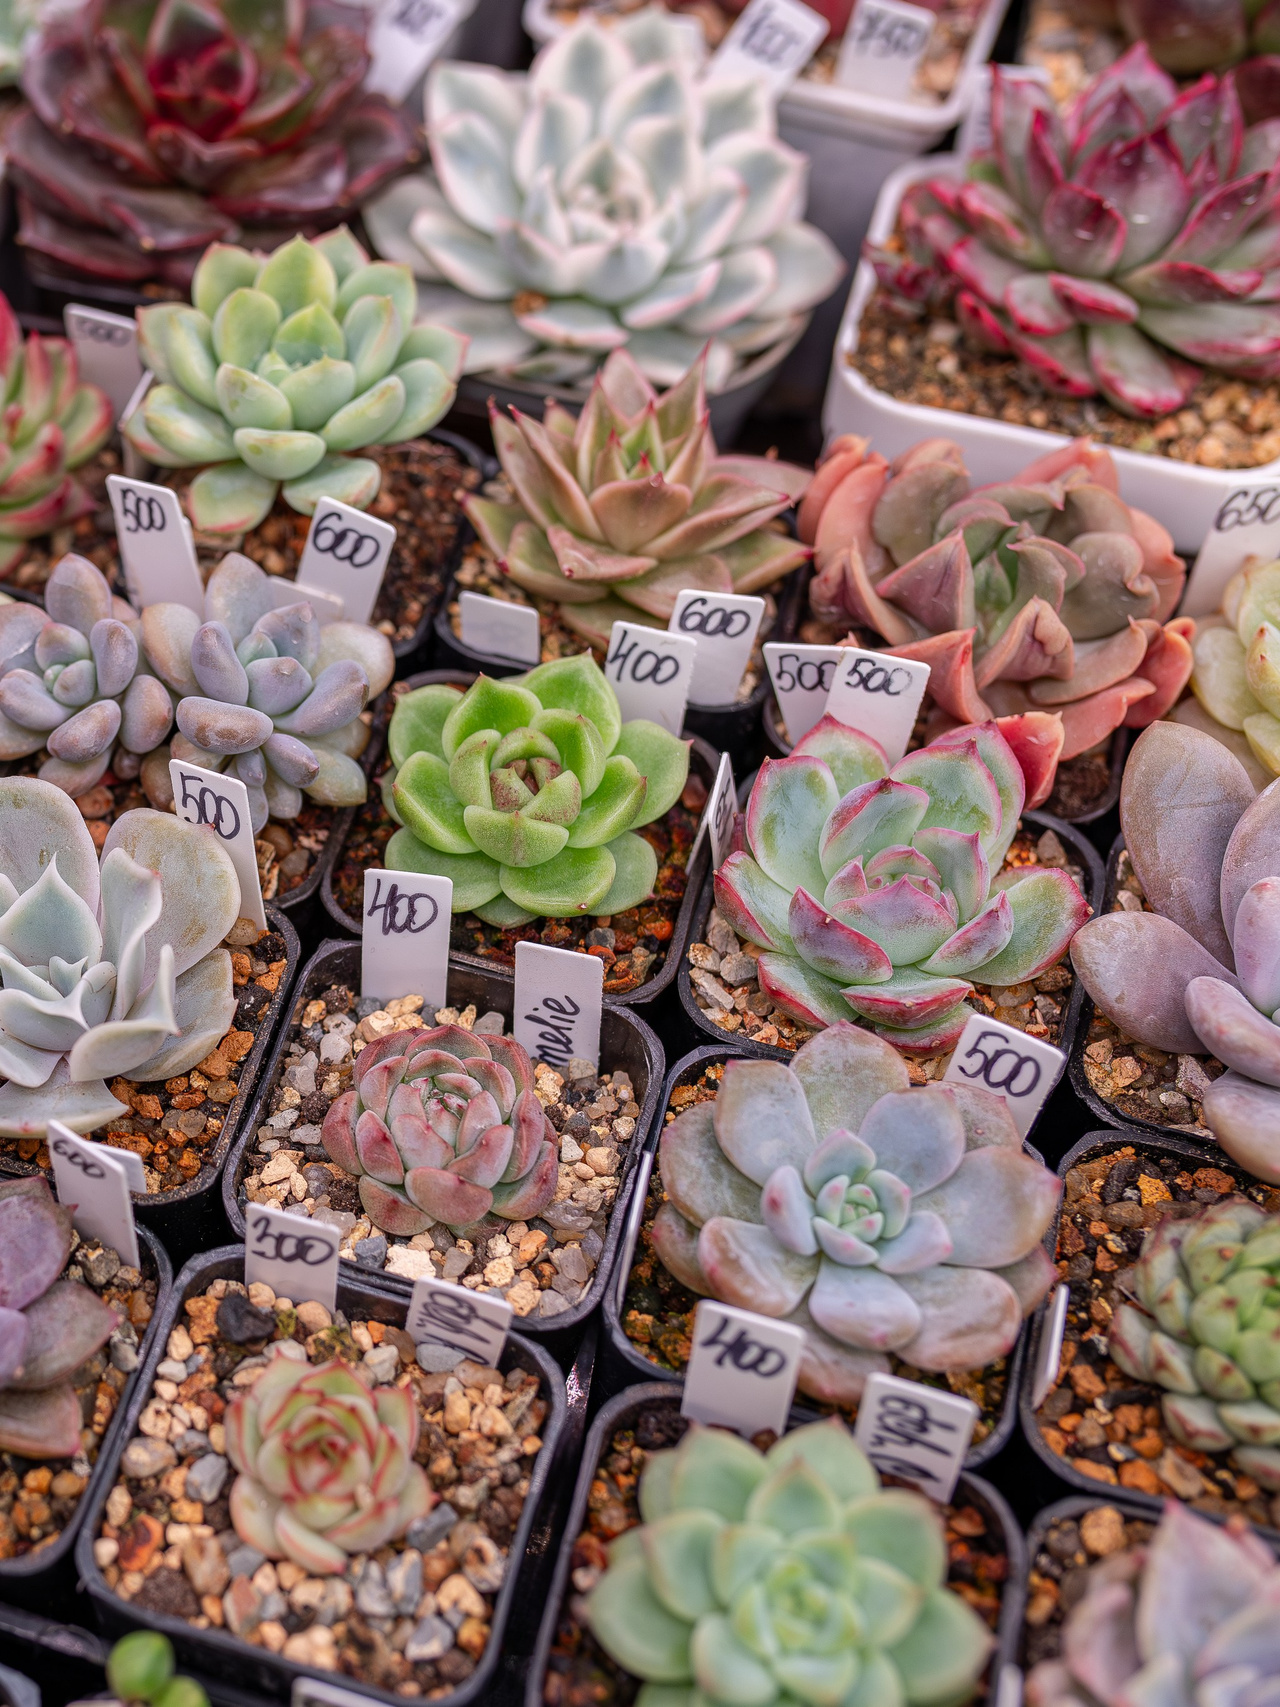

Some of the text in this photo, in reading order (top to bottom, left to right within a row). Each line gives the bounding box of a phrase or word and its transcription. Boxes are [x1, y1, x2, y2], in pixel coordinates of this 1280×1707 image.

[121, 488, 166, 533] 500
[313, 512, 381, 568] 600
[679, 597, 751, 637] 600
[609, 629, 680, 685] 400
[776, 653, 838, 692] 500
[845, 658, 913, 696] 500
[181, 775, 240, 841] 500
[367, 878, 438, 936] 400
[957, 1031, 1041, 1098] 500
[53, 1137, 106, 1180] 600
[252, 1215, 337, 1265] 300
[700, 1316, 787, 1378] 400
